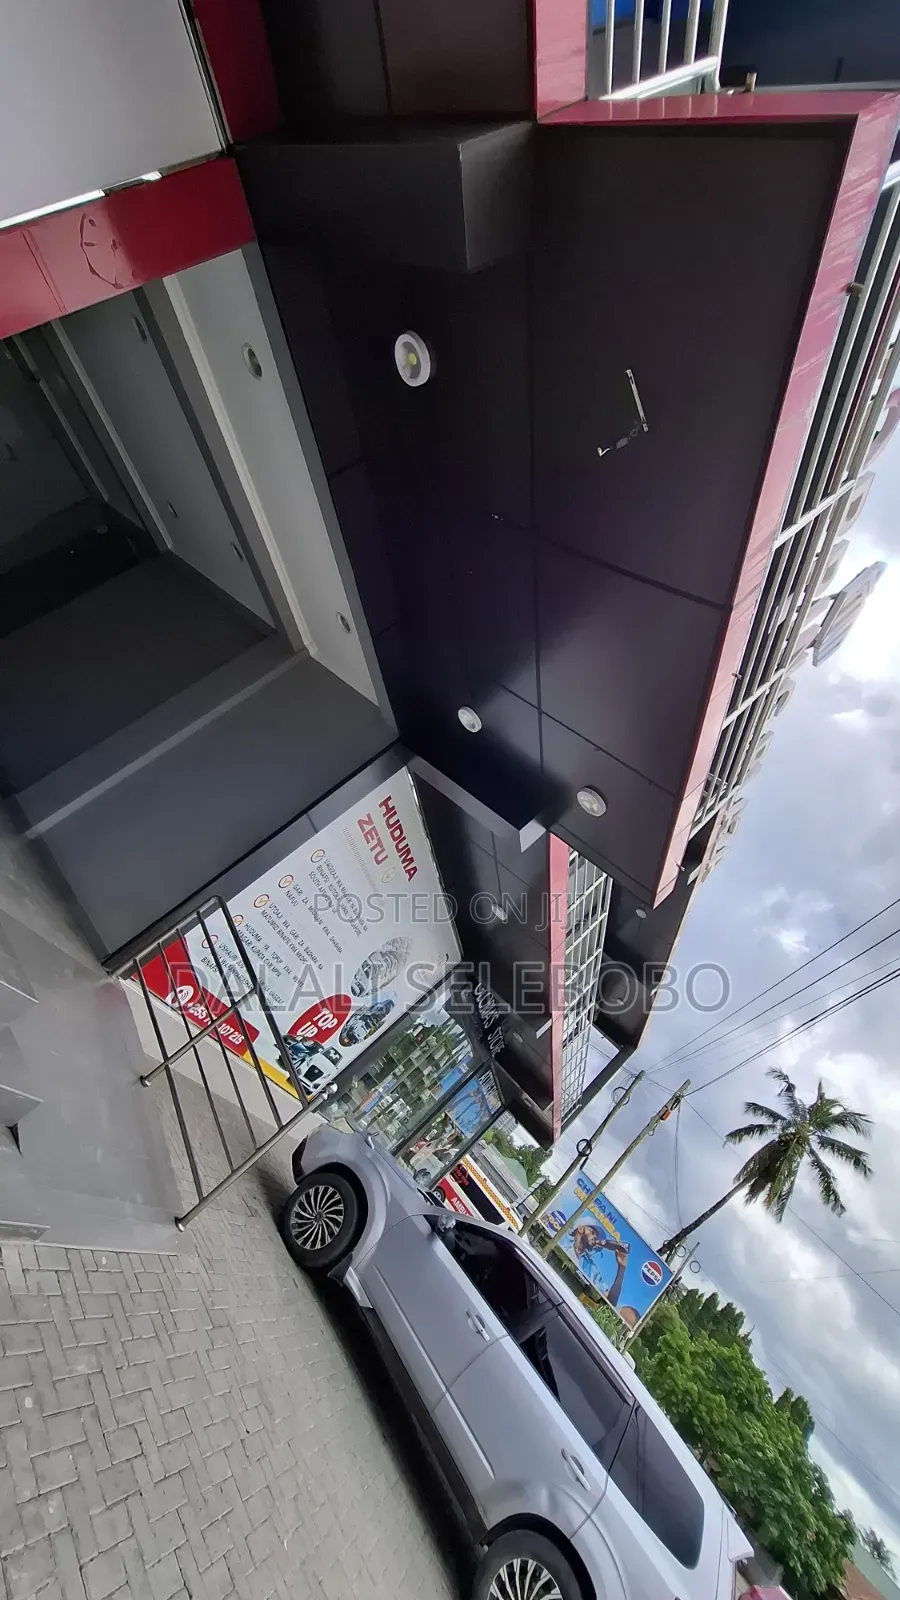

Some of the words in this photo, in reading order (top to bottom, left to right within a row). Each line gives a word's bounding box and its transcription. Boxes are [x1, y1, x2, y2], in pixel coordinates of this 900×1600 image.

[357, 813, 388, 866] ZETU
[378, 796, 417, 882] HUDUMA
[292, 883, 303, 896] GARI
[308, 870, 321, 888] SOUTH
[284, 889, 299, 907] NAFUU
[260, 909, 280, 931] MATUMIZI
[276, 928, 291, 945] BINAFSI
[287, 942, 298, 953] KWA
[268, 902, 284, 920] UTOAJI
[289, 928, 299, 940] GARI
[218, 942, 238, 961] USHAURI
[243, 922, 262, 942] HUDUMA
[270, 951, 283, 965] TOPUP
[282, 965, 292, 974] KWA
[249, 944, 265, 960] KUPATA
[262, 958, 273, 968] GARI
[270, 966, 282, 977] MPYA
[187, 1002, 209, 1020] +255
[217, 1023, 234, 1036] 107
[227, 1031, 245, 1045] 215
[296, 1021, 318, 1038] UP
[313, 1008, 338, 1030] TOP
[451, 1197, 470, 1217] AMBU
[577, 1178, 607, 1213] CHPA
[607, 1211, 617, 1224] NI
[643, 1263, 660, 1283] PEPSI
